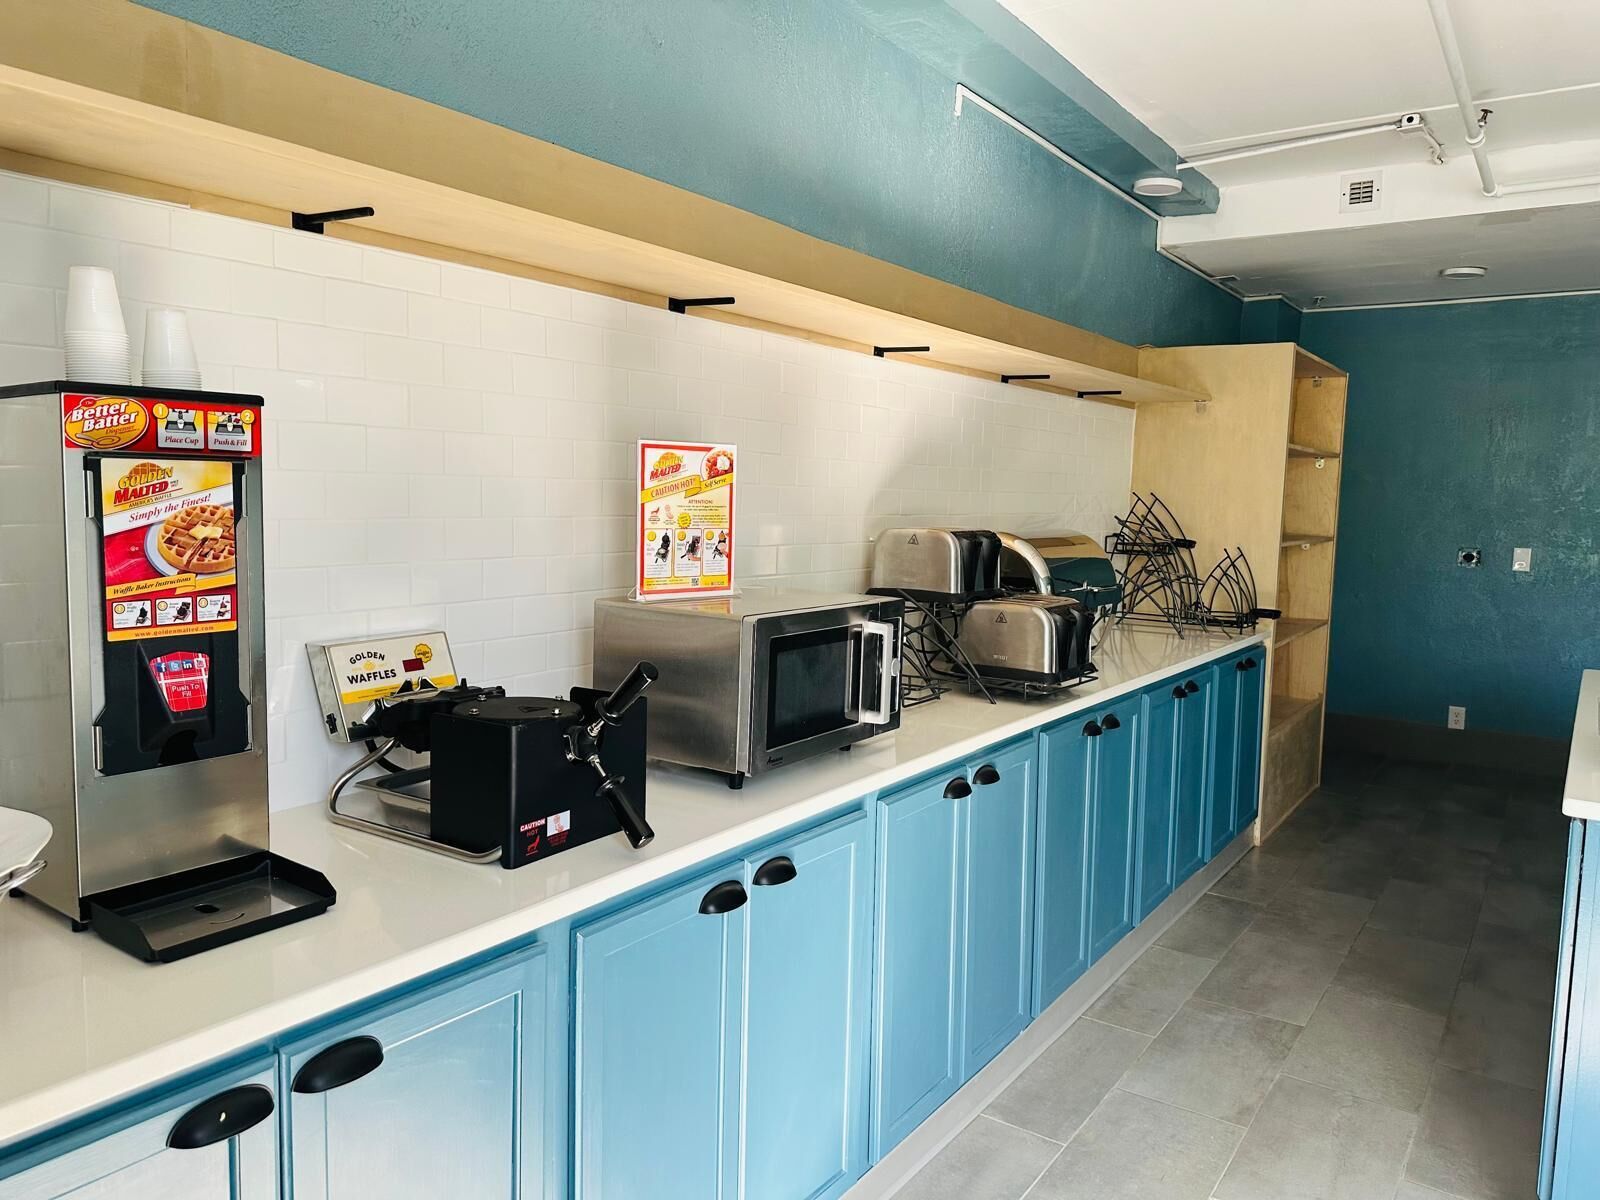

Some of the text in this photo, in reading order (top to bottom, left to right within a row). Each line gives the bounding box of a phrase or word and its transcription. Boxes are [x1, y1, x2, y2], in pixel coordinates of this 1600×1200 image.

[71, 401, 129, 422] Better
[83, 412, 138, 432] Batter
[164, 436, 199, 446] Place Cup
[213, 438, 230, 446] Push
[118, 466, 174, 489] GOLDEN
[650, 463, 682, 480] MALTED
[113, 480, 169, 504] MALTED
[651, 482, 680, 498] CAUTION
[128, 493, 212, 523] Simply the Finest!
[113, 586, 134, 595] Waffle
[155, 577, 192, 587] Instructions
[349, 651, 386, 665] GOLDEN
[347, 669, 397, 685] WAFFLES
[520, 818, 546, 832] CAUTION
